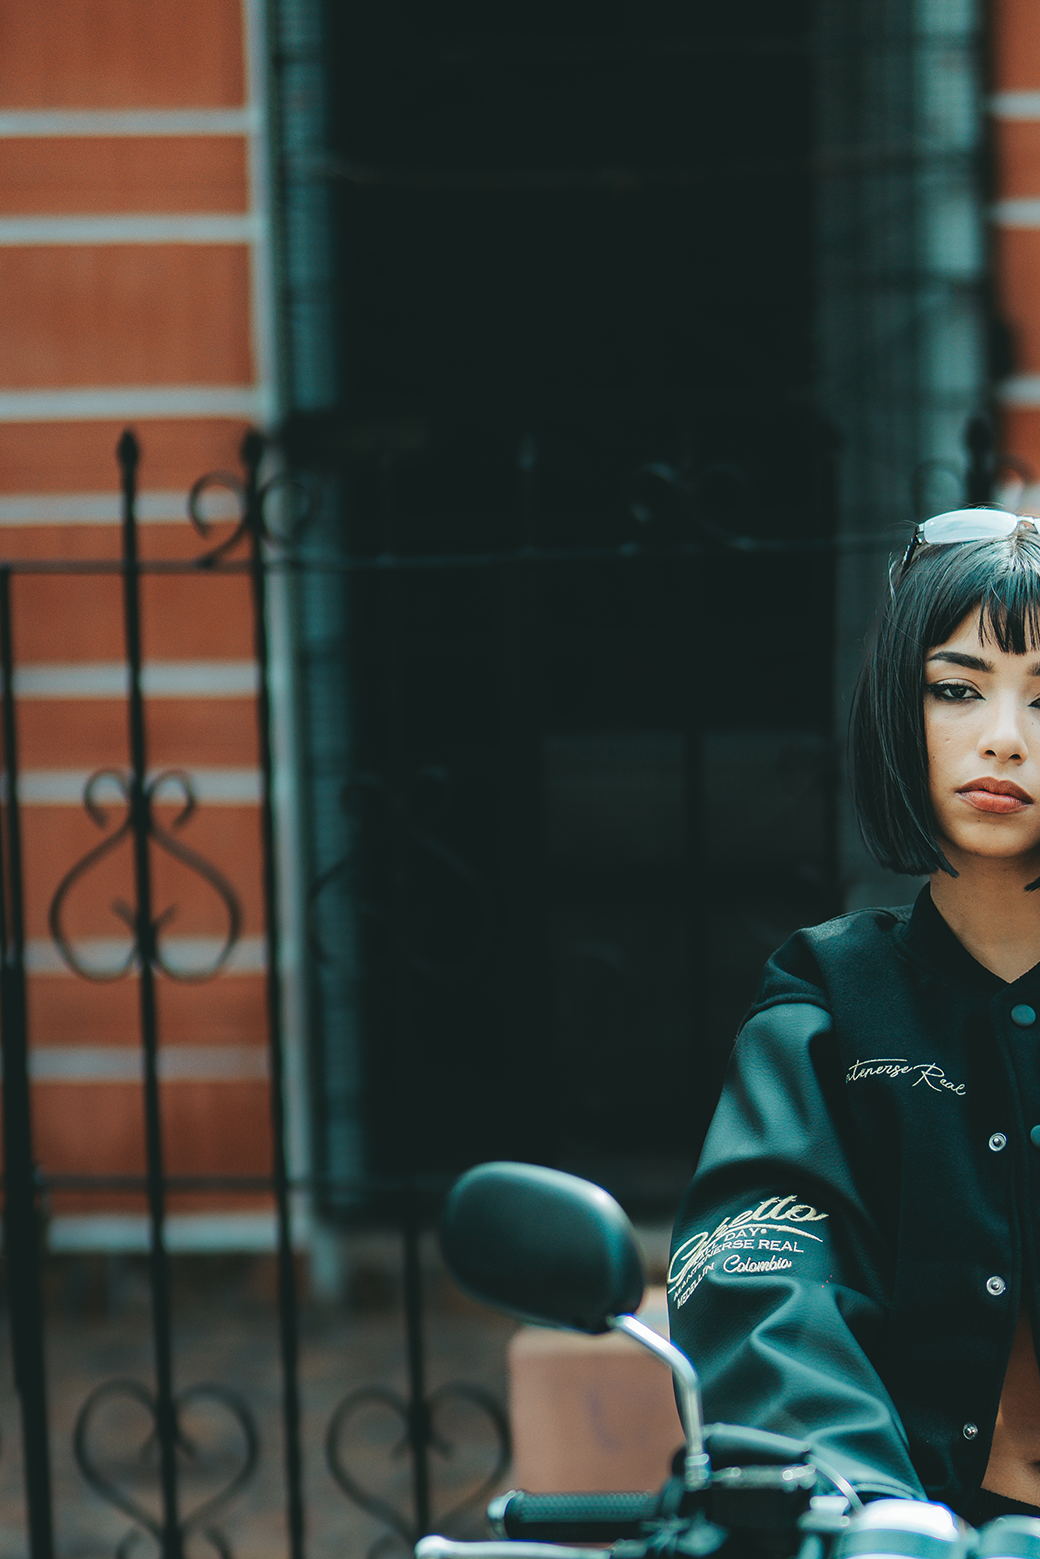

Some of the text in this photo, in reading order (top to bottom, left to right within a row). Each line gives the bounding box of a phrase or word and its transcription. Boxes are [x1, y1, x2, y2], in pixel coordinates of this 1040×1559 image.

[912, 1062, 966, 1096] Real
[666, 1194, 830, 1287] Ghetto
[758, 1239, 804, 1253] REAL
[722, 1254, 793, 1274] Colombia
